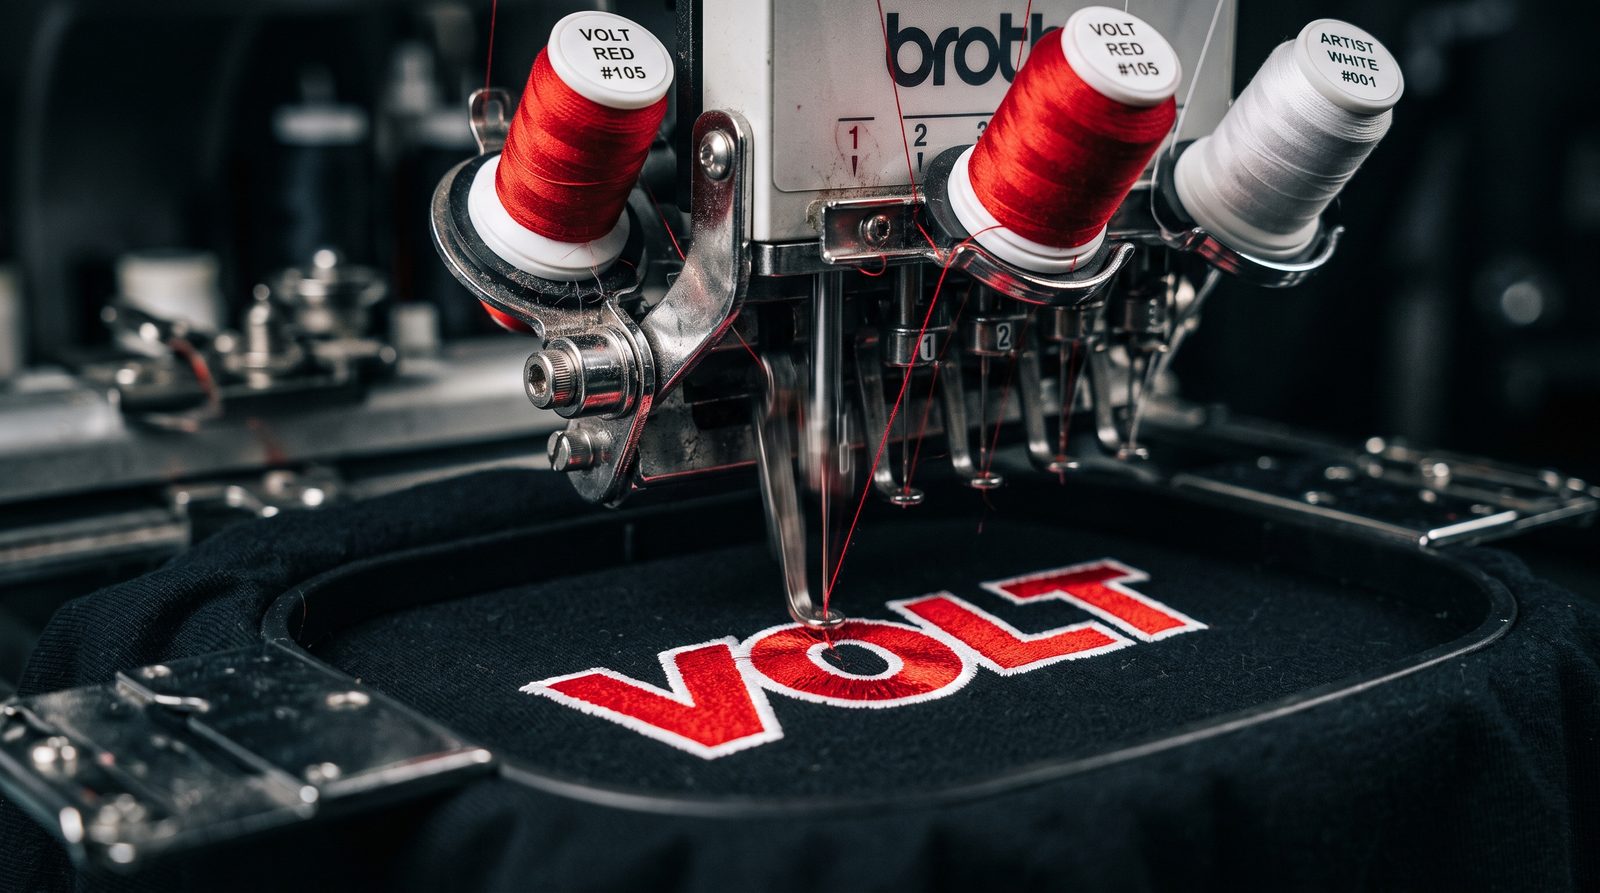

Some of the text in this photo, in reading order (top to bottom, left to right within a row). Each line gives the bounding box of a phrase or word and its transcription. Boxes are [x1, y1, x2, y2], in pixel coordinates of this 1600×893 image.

[579, 28, 630, 42] VOLT
[1088, 22, 1136, 36] VOLT
[1105, 42, 1145, 56] RED
[1320, 32, 1374, 54] ARTIST
[592, 47, 635, 60] RED
[1327, 50, 1379, 72] WHITE
[600, 66, 646, 80] #105
[1118, 61, 1159, 76] #105
[1341, 70, 1377, 88] #001
[848, 125, 859, 149] 1
[914, 123, 928, 147] 2
[998, 325, 1010, 348] 2
[923, 335, 932, 358] 1
[519, 557, 1209, 760] VOLT
